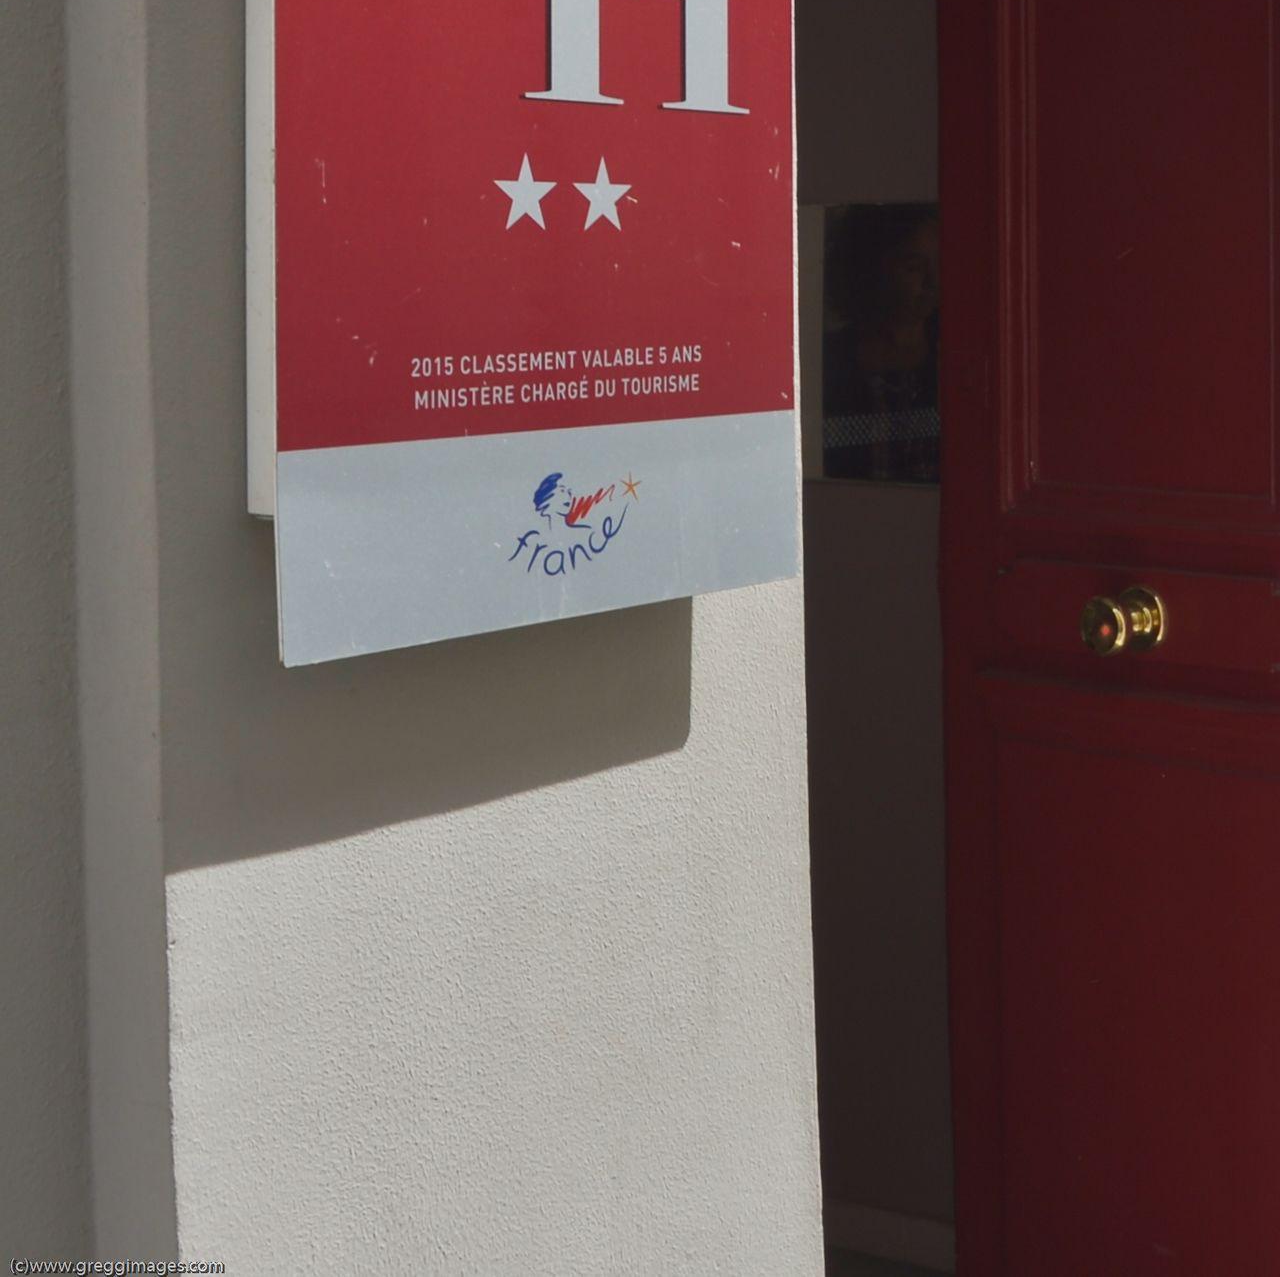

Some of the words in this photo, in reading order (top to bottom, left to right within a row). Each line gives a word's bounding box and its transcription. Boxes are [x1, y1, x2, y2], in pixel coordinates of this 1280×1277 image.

[410, 356, 454, 378] 2015
[460, 350, 577, 375] CLASSEMENT
[581, 346, 654, 368] VALABLE
[658, 346, 668, 365] 5
[671, 344, 703, 364] ANS
[414, 382, 515, 410] MINISTÈRE
[520, 376, 589, 403] CHARGÉ
[594, 378, 616, 398] DU
[621, 373, 700, 396] TOURISME
